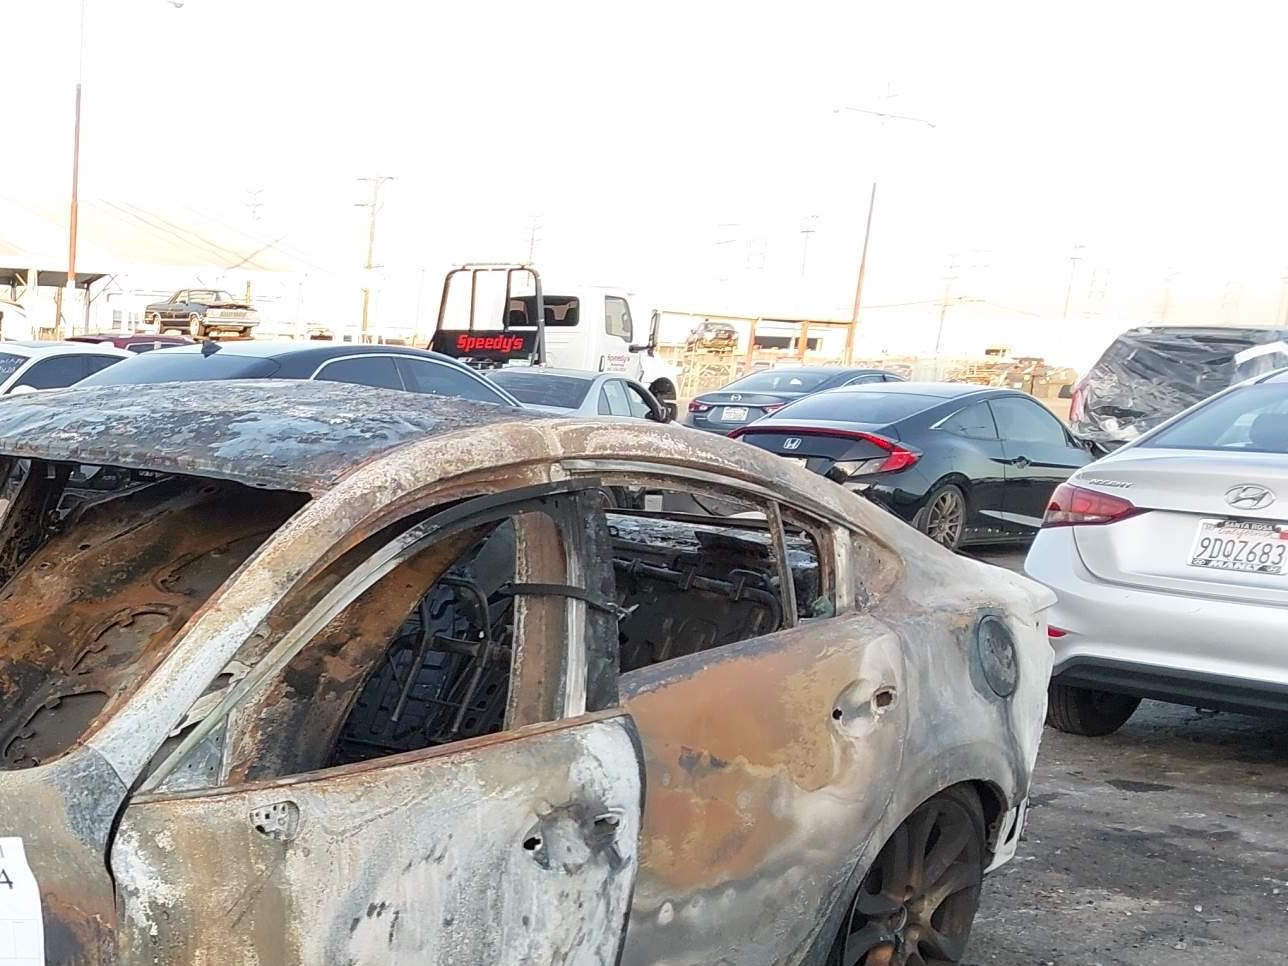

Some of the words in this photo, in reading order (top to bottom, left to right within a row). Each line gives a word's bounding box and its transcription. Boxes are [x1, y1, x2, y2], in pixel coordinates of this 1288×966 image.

[456, 333, 524, 353] Speedy's
[1224, 520, 1250, 530] SANTA
[1252, 523, 1274, 532] ROSA
[1195, 537, 1287, 565] 9DQZ683
